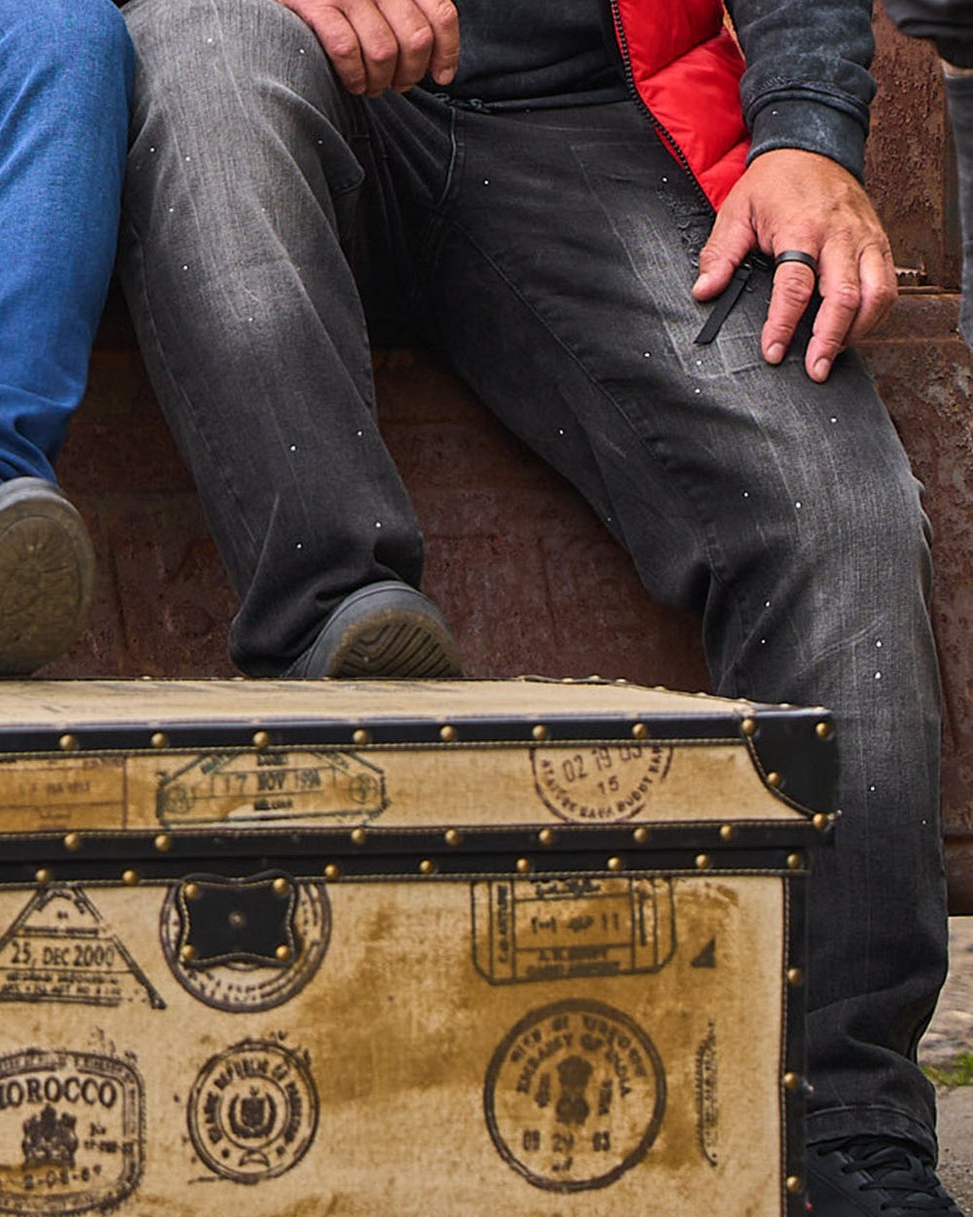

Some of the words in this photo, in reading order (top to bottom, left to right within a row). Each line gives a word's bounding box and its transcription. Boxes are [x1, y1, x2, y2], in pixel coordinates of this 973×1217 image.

[597, 776, 620, 795] 15
[43, 946, 71, 966] DEC
[73, 944, 115, 967] 2000
